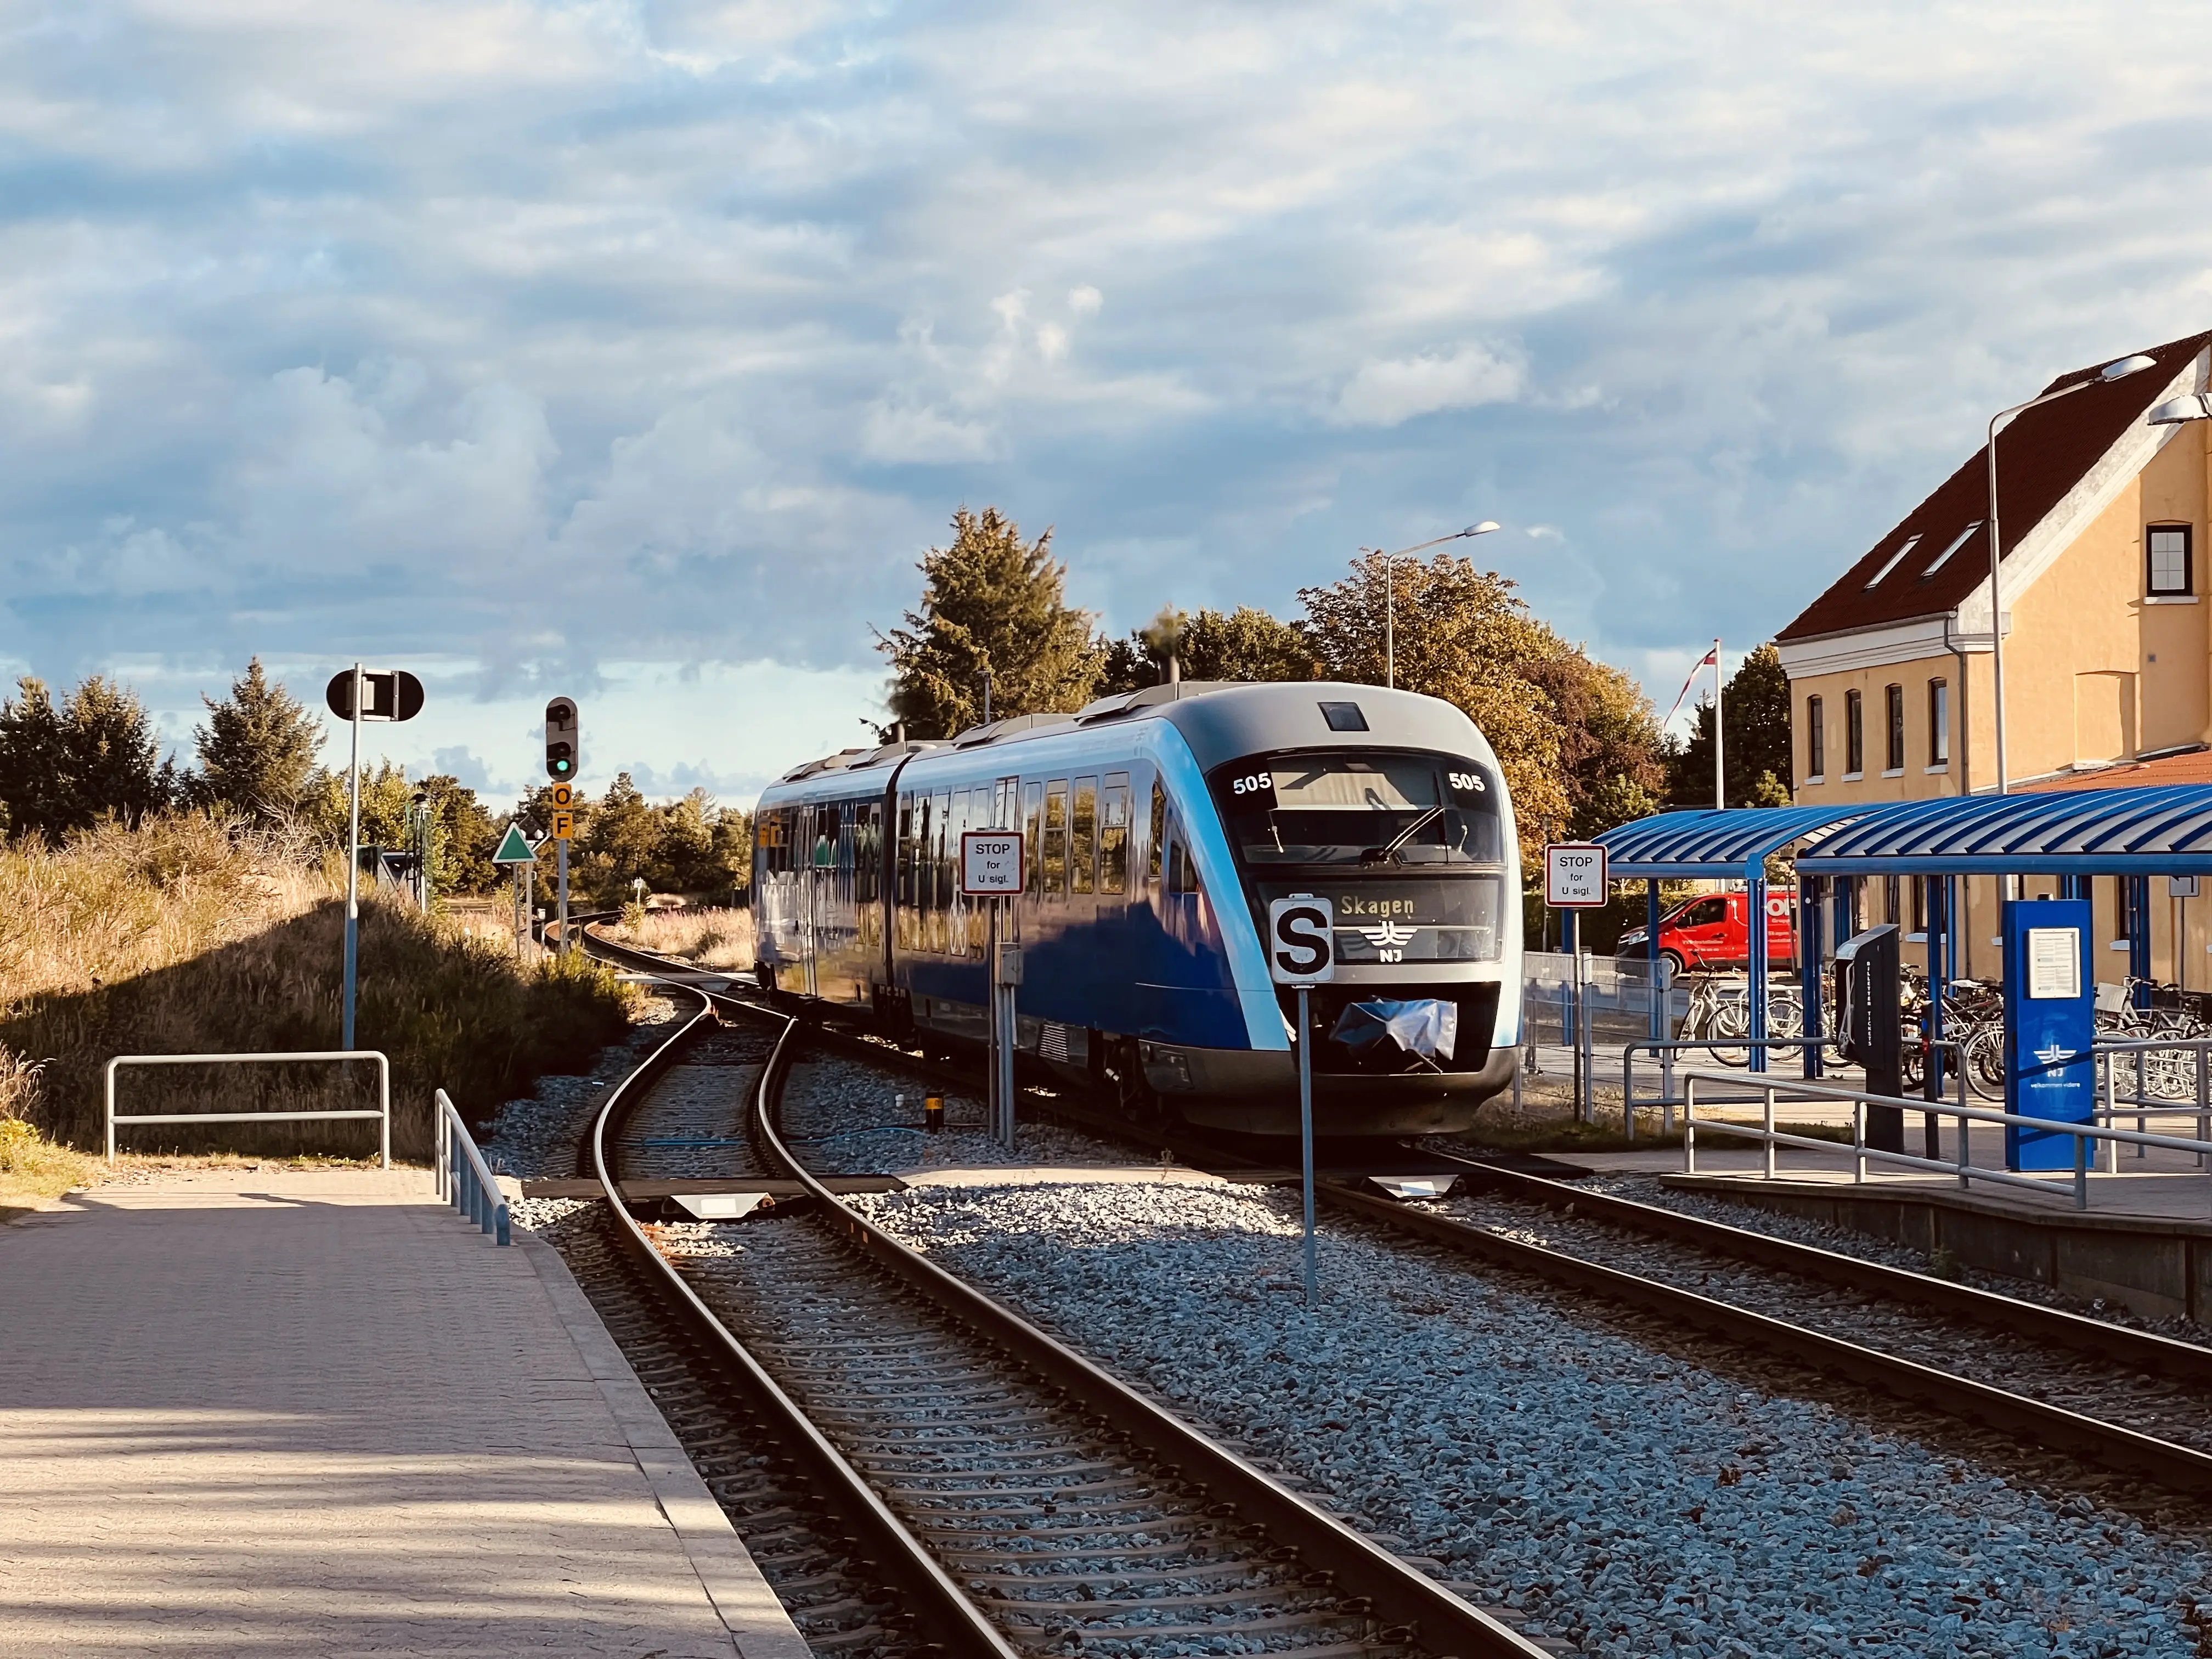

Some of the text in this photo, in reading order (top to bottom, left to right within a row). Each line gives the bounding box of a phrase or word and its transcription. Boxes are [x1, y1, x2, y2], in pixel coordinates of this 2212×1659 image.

[1233, 772, 1272, 794] 505
[1448, 772, 1486, 791] 505
[555, 788, 570, 805] O
[557, 817, 569, 834] F
[976, 844, 1010, 854] STOP
[987, 861, 1000, 869] for
[1560, 856, 1593, 867] STOP
[978, 874, 985, 883] U
[1562, 887, 1568, 895] U
[1341, 896, 1414, 917] Skagen
[1276, 907, 1330, 975] S
[1379, 949, 1402, 962] NJ
[2047, 1068, 2064, 1077] NJ
